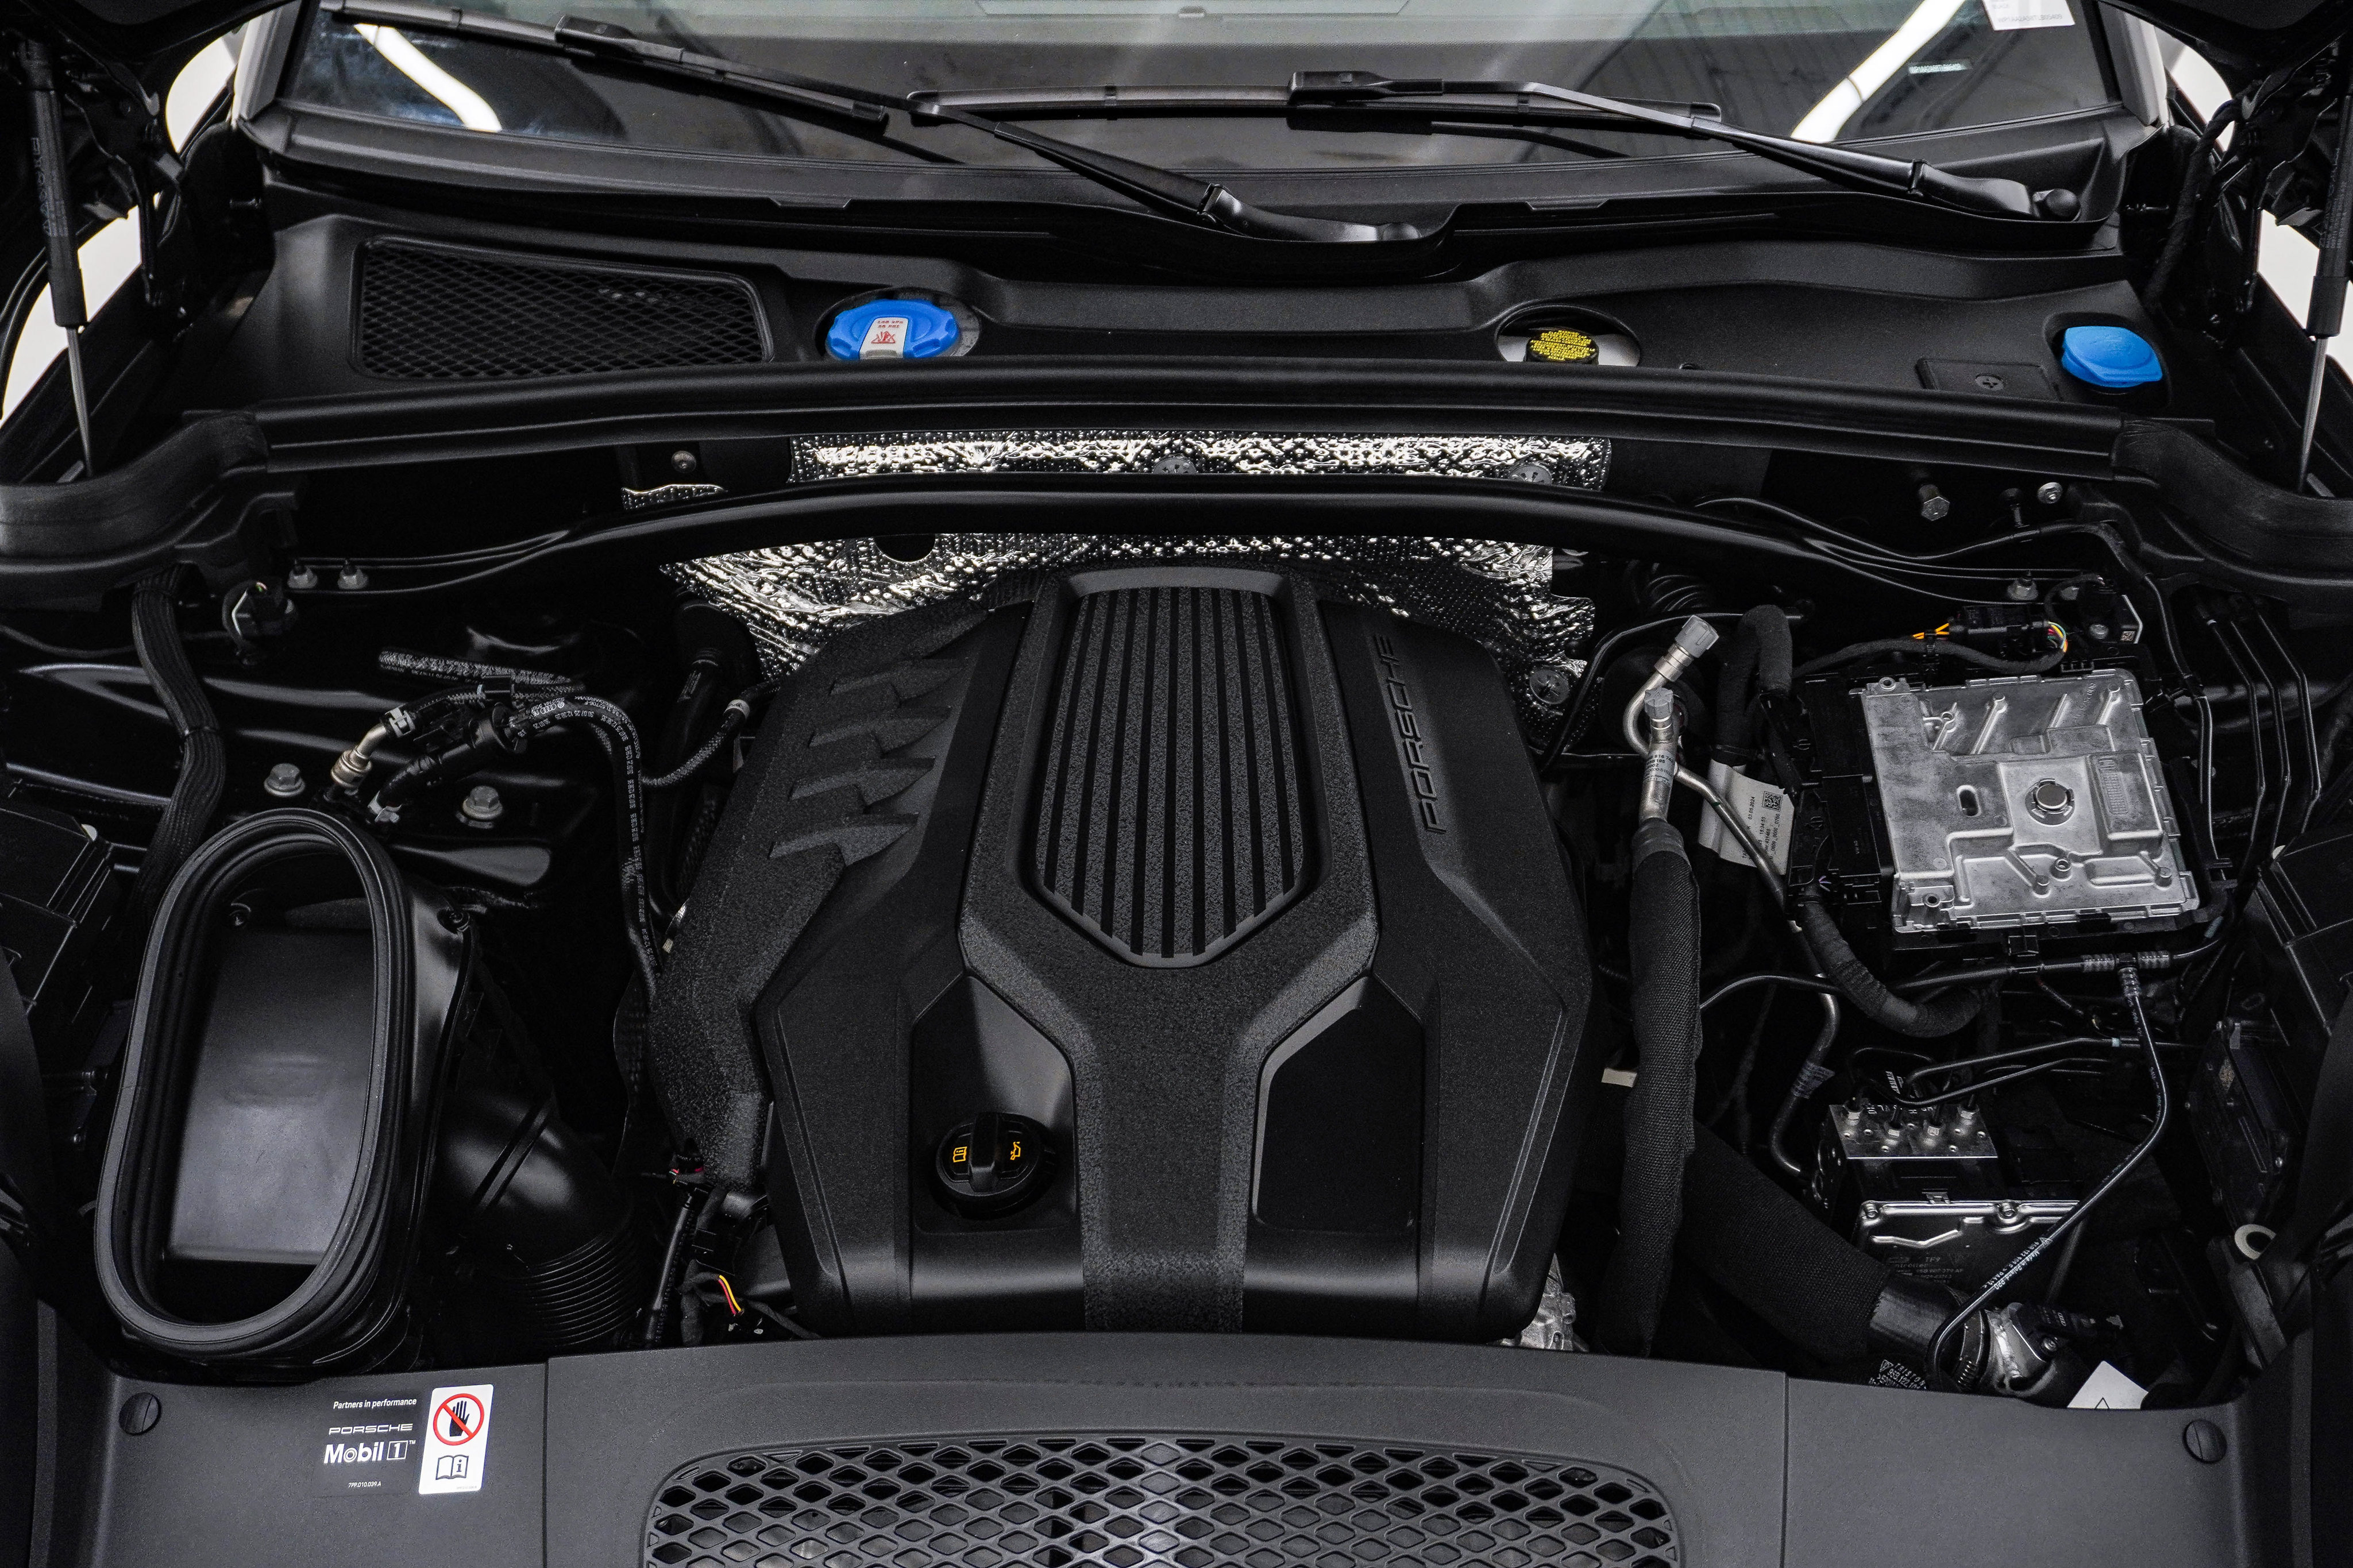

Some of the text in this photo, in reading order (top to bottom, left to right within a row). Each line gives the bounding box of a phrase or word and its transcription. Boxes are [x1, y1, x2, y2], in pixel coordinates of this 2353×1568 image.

[1374, 635, 1446, 833] PORSCHE
[333, 1397, 417, 1409] Partners in performance
[329, 1423, 413, 1435] PORSCHE
[323, 1441, 384, 1464] Mobil
